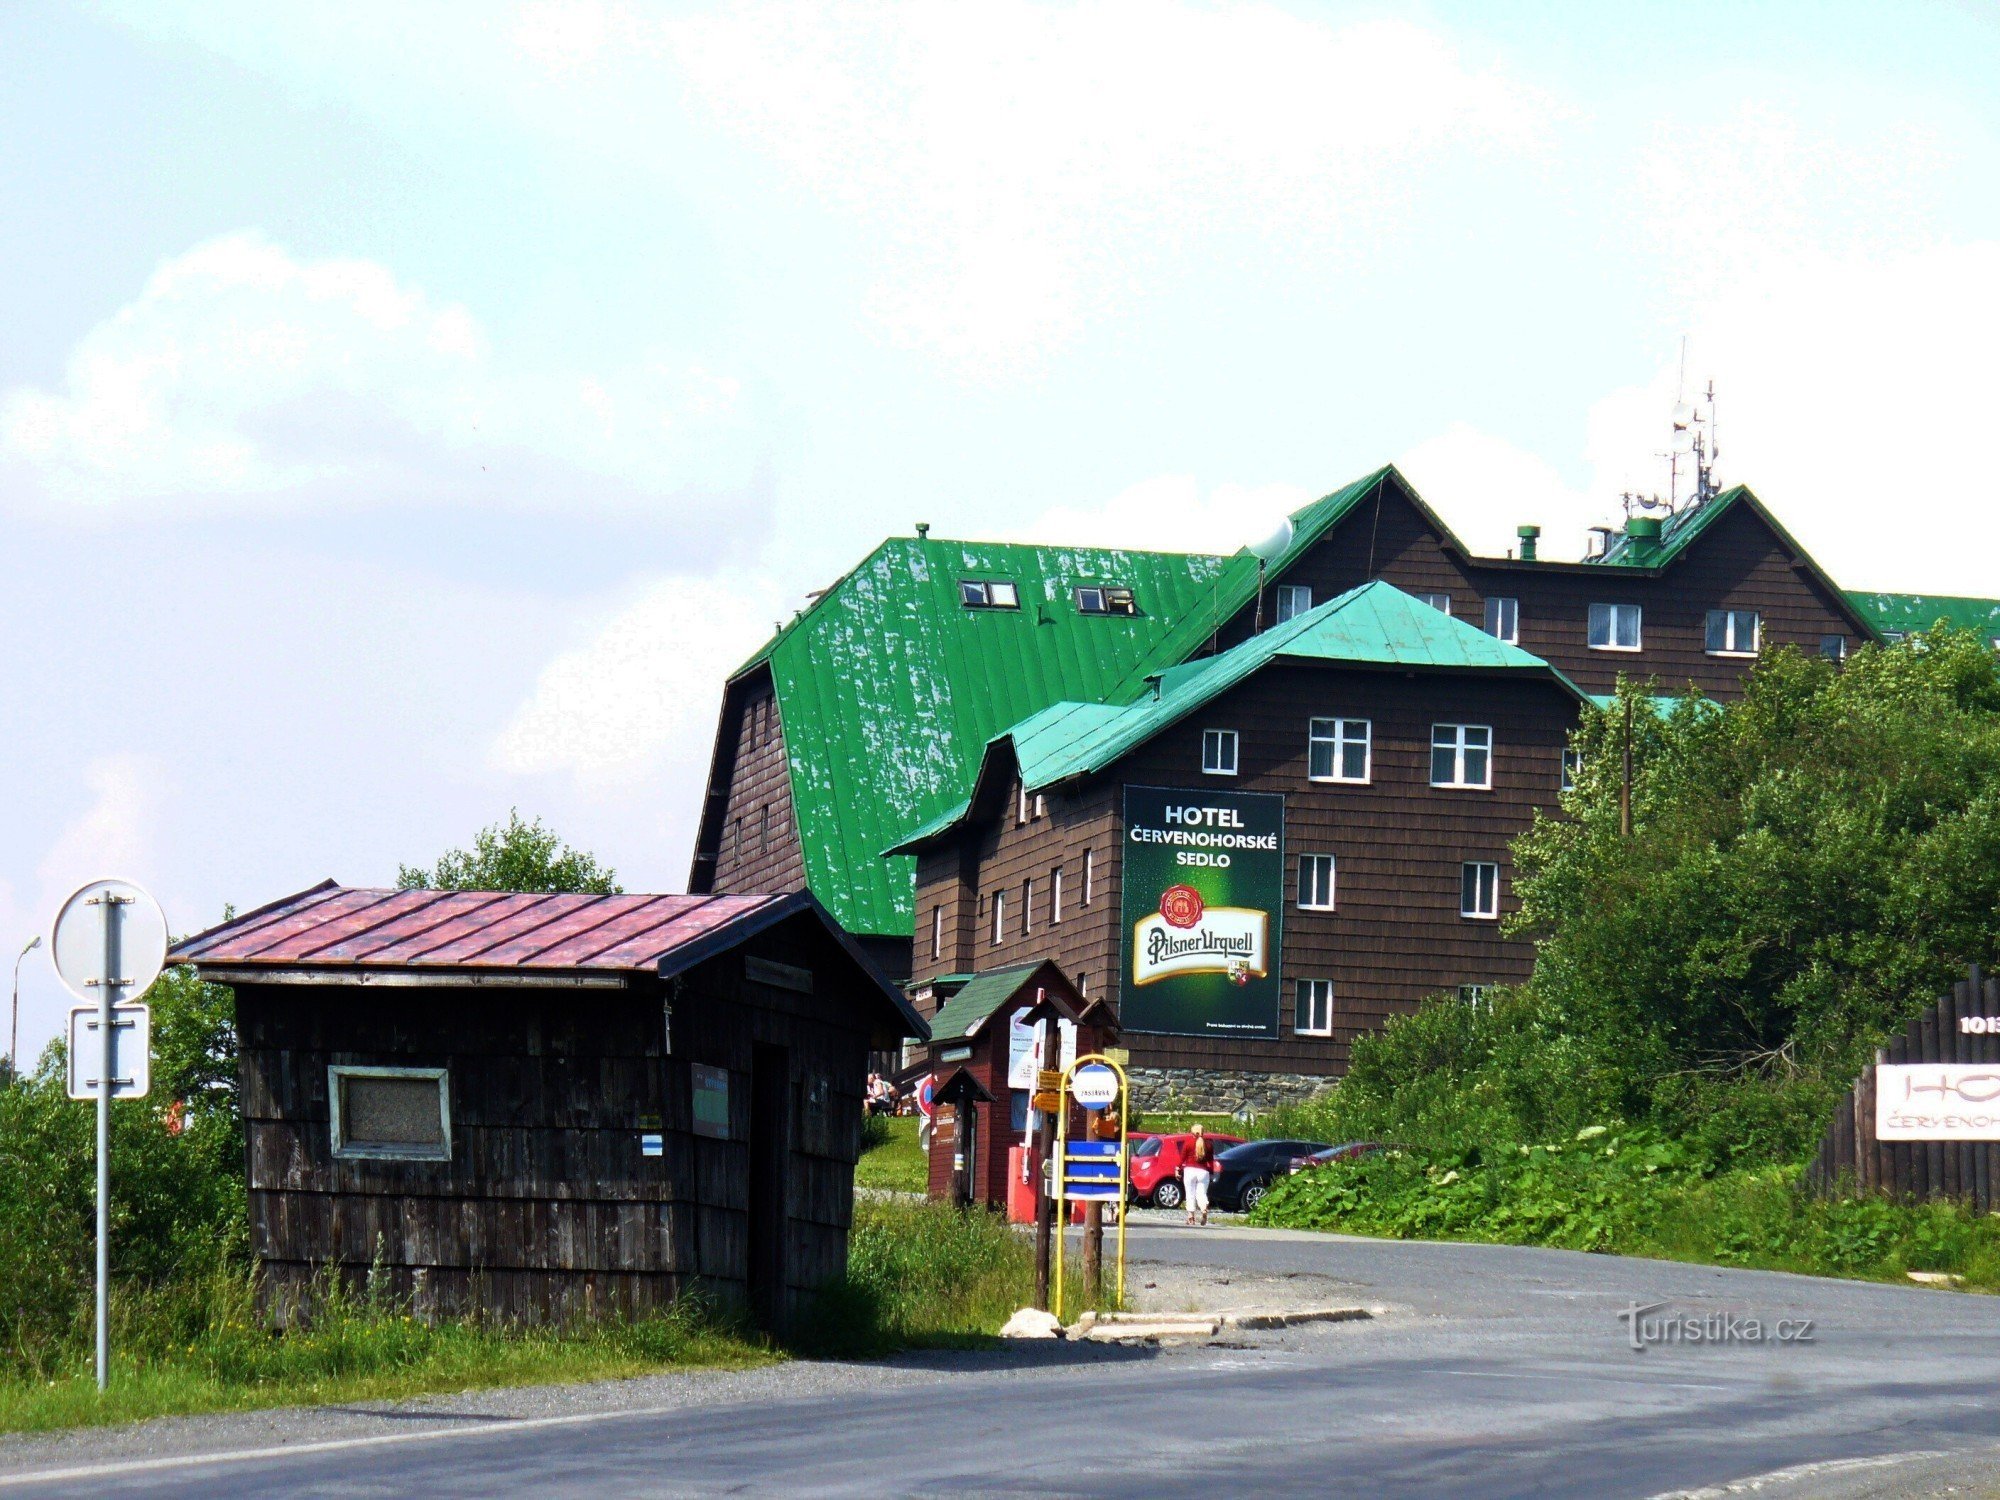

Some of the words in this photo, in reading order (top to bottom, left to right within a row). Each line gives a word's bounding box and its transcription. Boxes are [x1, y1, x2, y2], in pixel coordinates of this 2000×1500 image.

[1166, 806, 1244, 828] HOTEL
[1130, 825, 1277, 850] ČERVENOHORSKÉ
[1176, 852, 1231, 868] SEDLO
[1148, 927, 1201, 965] Pilsner
[1201, 928, 1253, 958] Urquell
